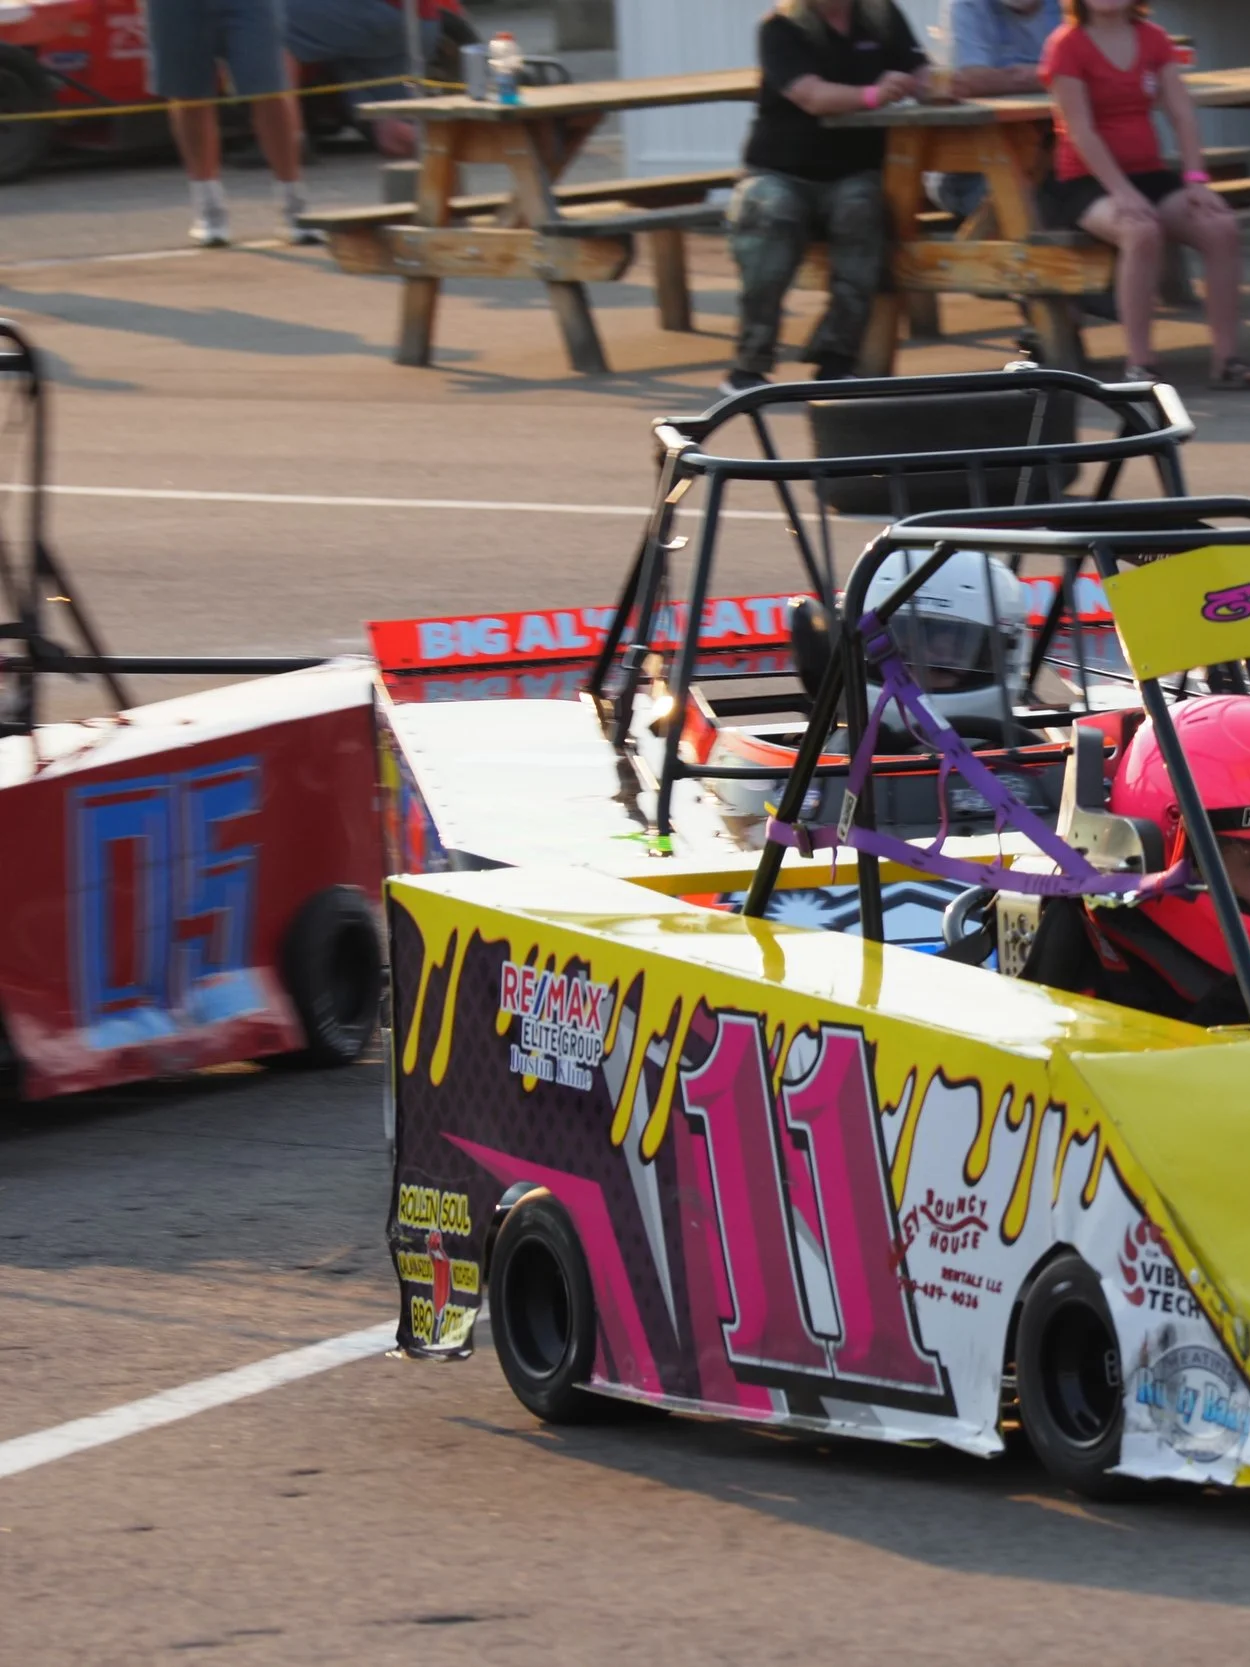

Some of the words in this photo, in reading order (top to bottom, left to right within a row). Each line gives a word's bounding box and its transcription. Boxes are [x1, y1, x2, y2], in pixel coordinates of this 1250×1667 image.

[417, 617, 510, 660] BIG
[502, 964, 603, 1032] RE/MAX
[523, 1021, 559, 1051] ELITE
[561, 1031, 602, 1063] GROUP
[400, 1189, 439, 1227] ROLLIN
[441, 1197, 470, 1231] SOUL
[679, 1012, 950, 1400] 11
[929, 1231, 981, 1254] HOUSE
[412, 1301, 433, 1337] BBQ
[1148, 1289, 1201, 1319] TECH
